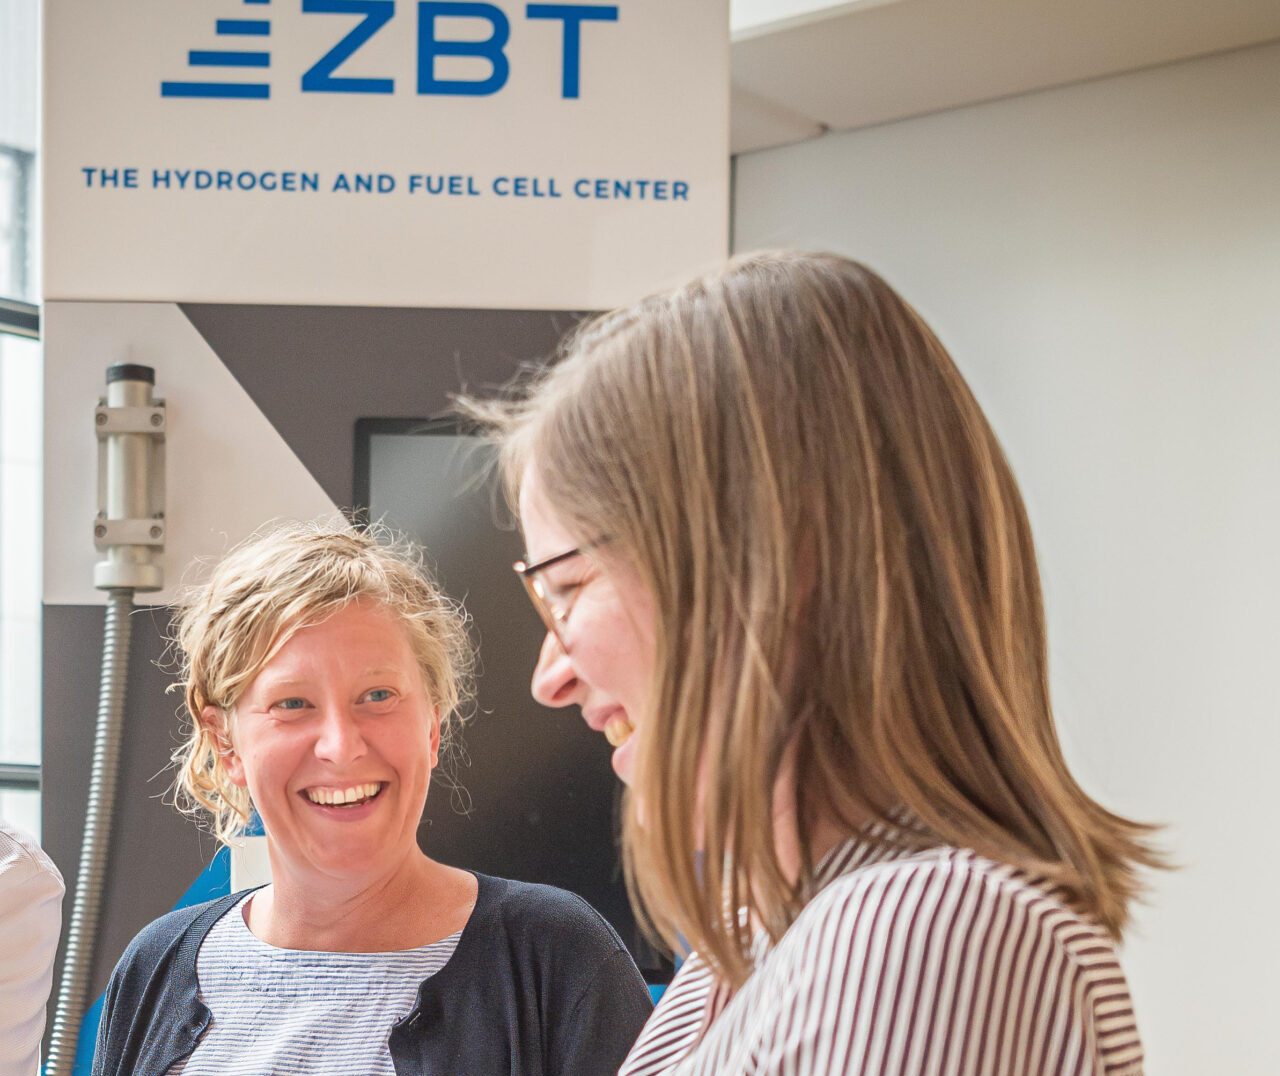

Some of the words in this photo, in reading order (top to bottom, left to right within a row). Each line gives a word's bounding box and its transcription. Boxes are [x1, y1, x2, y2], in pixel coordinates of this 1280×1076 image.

[300, 0, 620, 100] ZBT
[81, 167, 139, 189] THE
[151, 169, 320, 193] HYDROGEN
[331, 172, 397, 195] AND
[407, 173, 481, 197] FUEL
[491, 176, 561, 199] CELL
[573, 178, 690, 201] CENTER
